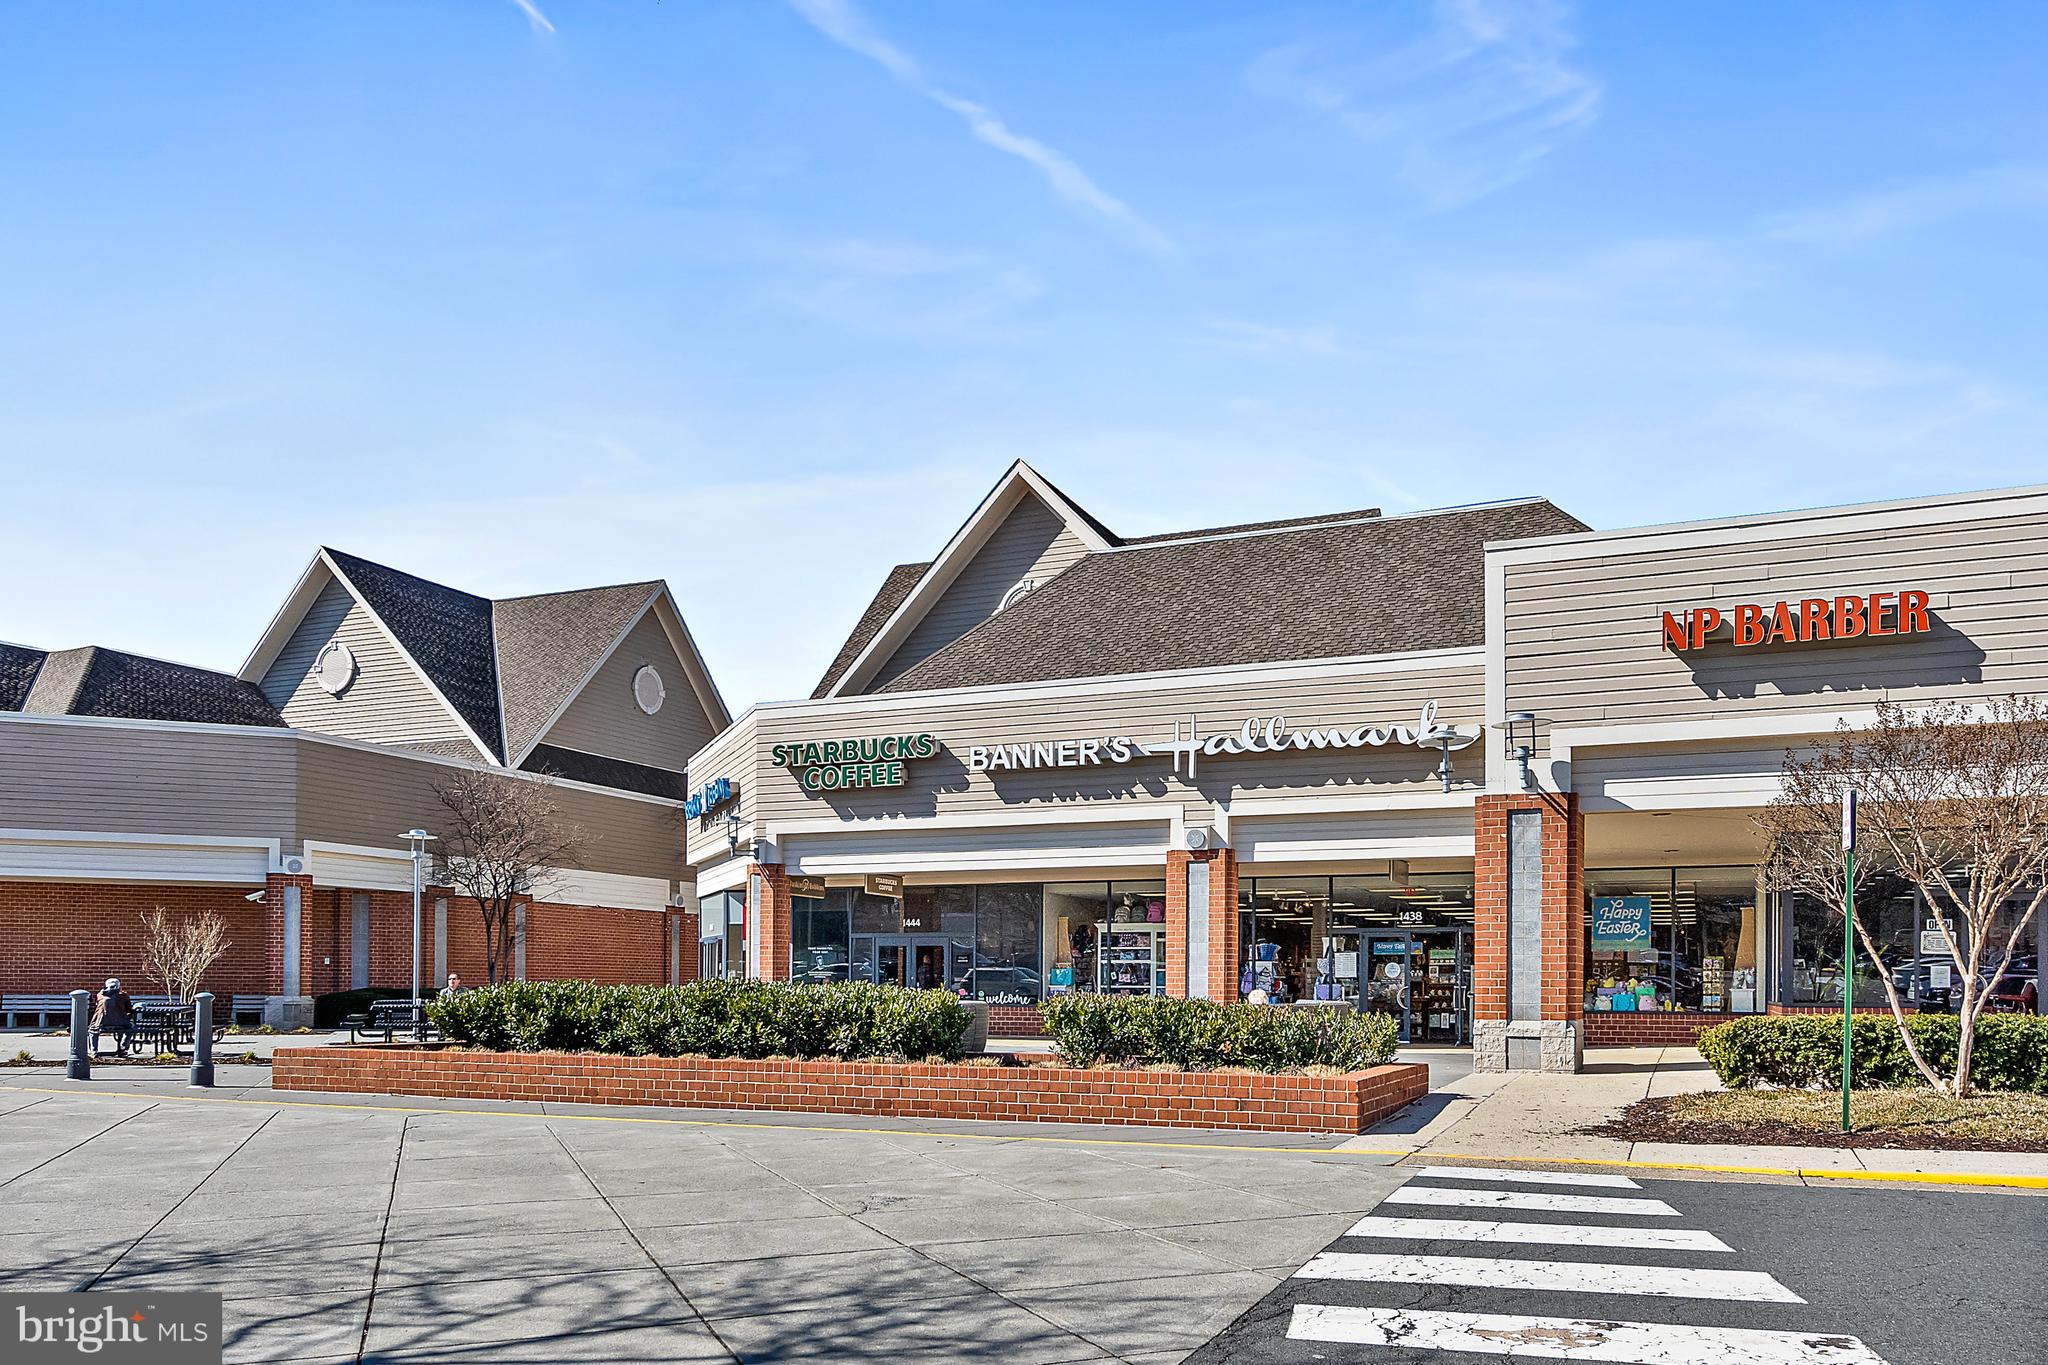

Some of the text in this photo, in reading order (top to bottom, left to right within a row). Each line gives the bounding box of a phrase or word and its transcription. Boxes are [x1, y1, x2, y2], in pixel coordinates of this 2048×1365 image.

[1662, 590, 1931, 651] NP BARBER
[969, 699, 1480, 779] BANNER'S Hallmark
[772, 733, 937, 768] STARBUCKS
[803, 761, 906, 792] COFFEE
[1399, 911, 1423, 921] 1438
[1600, 900, 1643, 920] Happy
[902, 918, 920, 927] 1444
[1928, 920, 1951, 930] OPN
[985, 991, 1031, 1005] welcome
